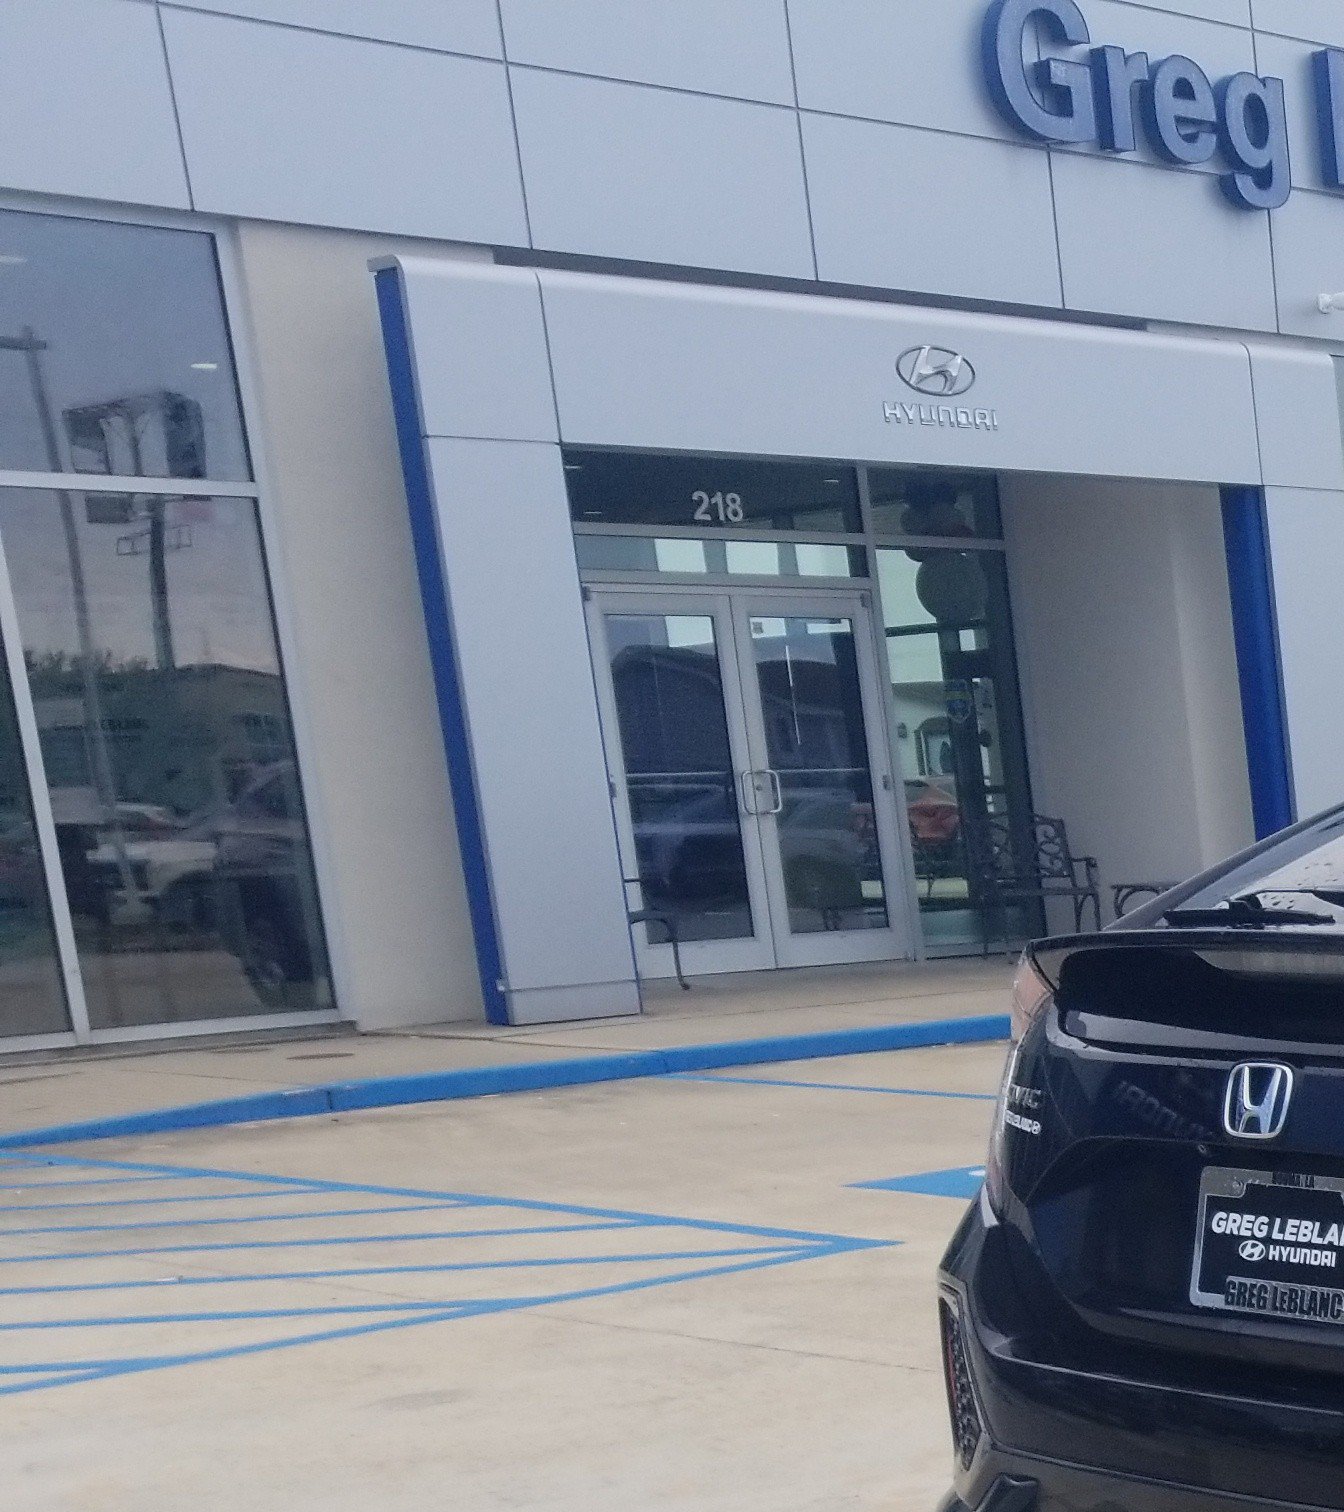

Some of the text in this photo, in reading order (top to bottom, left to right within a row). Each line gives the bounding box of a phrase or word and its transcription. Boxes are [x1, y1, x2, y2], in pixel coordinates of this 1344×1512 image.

[981, 0, 1291, 210] Greg
[882, 400, 998, 431] HYUNDAI
[691, 490, 744, 523] 218
[1211, 1211, 1270, 1239] GREG
[1268, 1244, 1337, 1268] HYUNDAI
[1225, 1279, 1269, 1310] GREG
